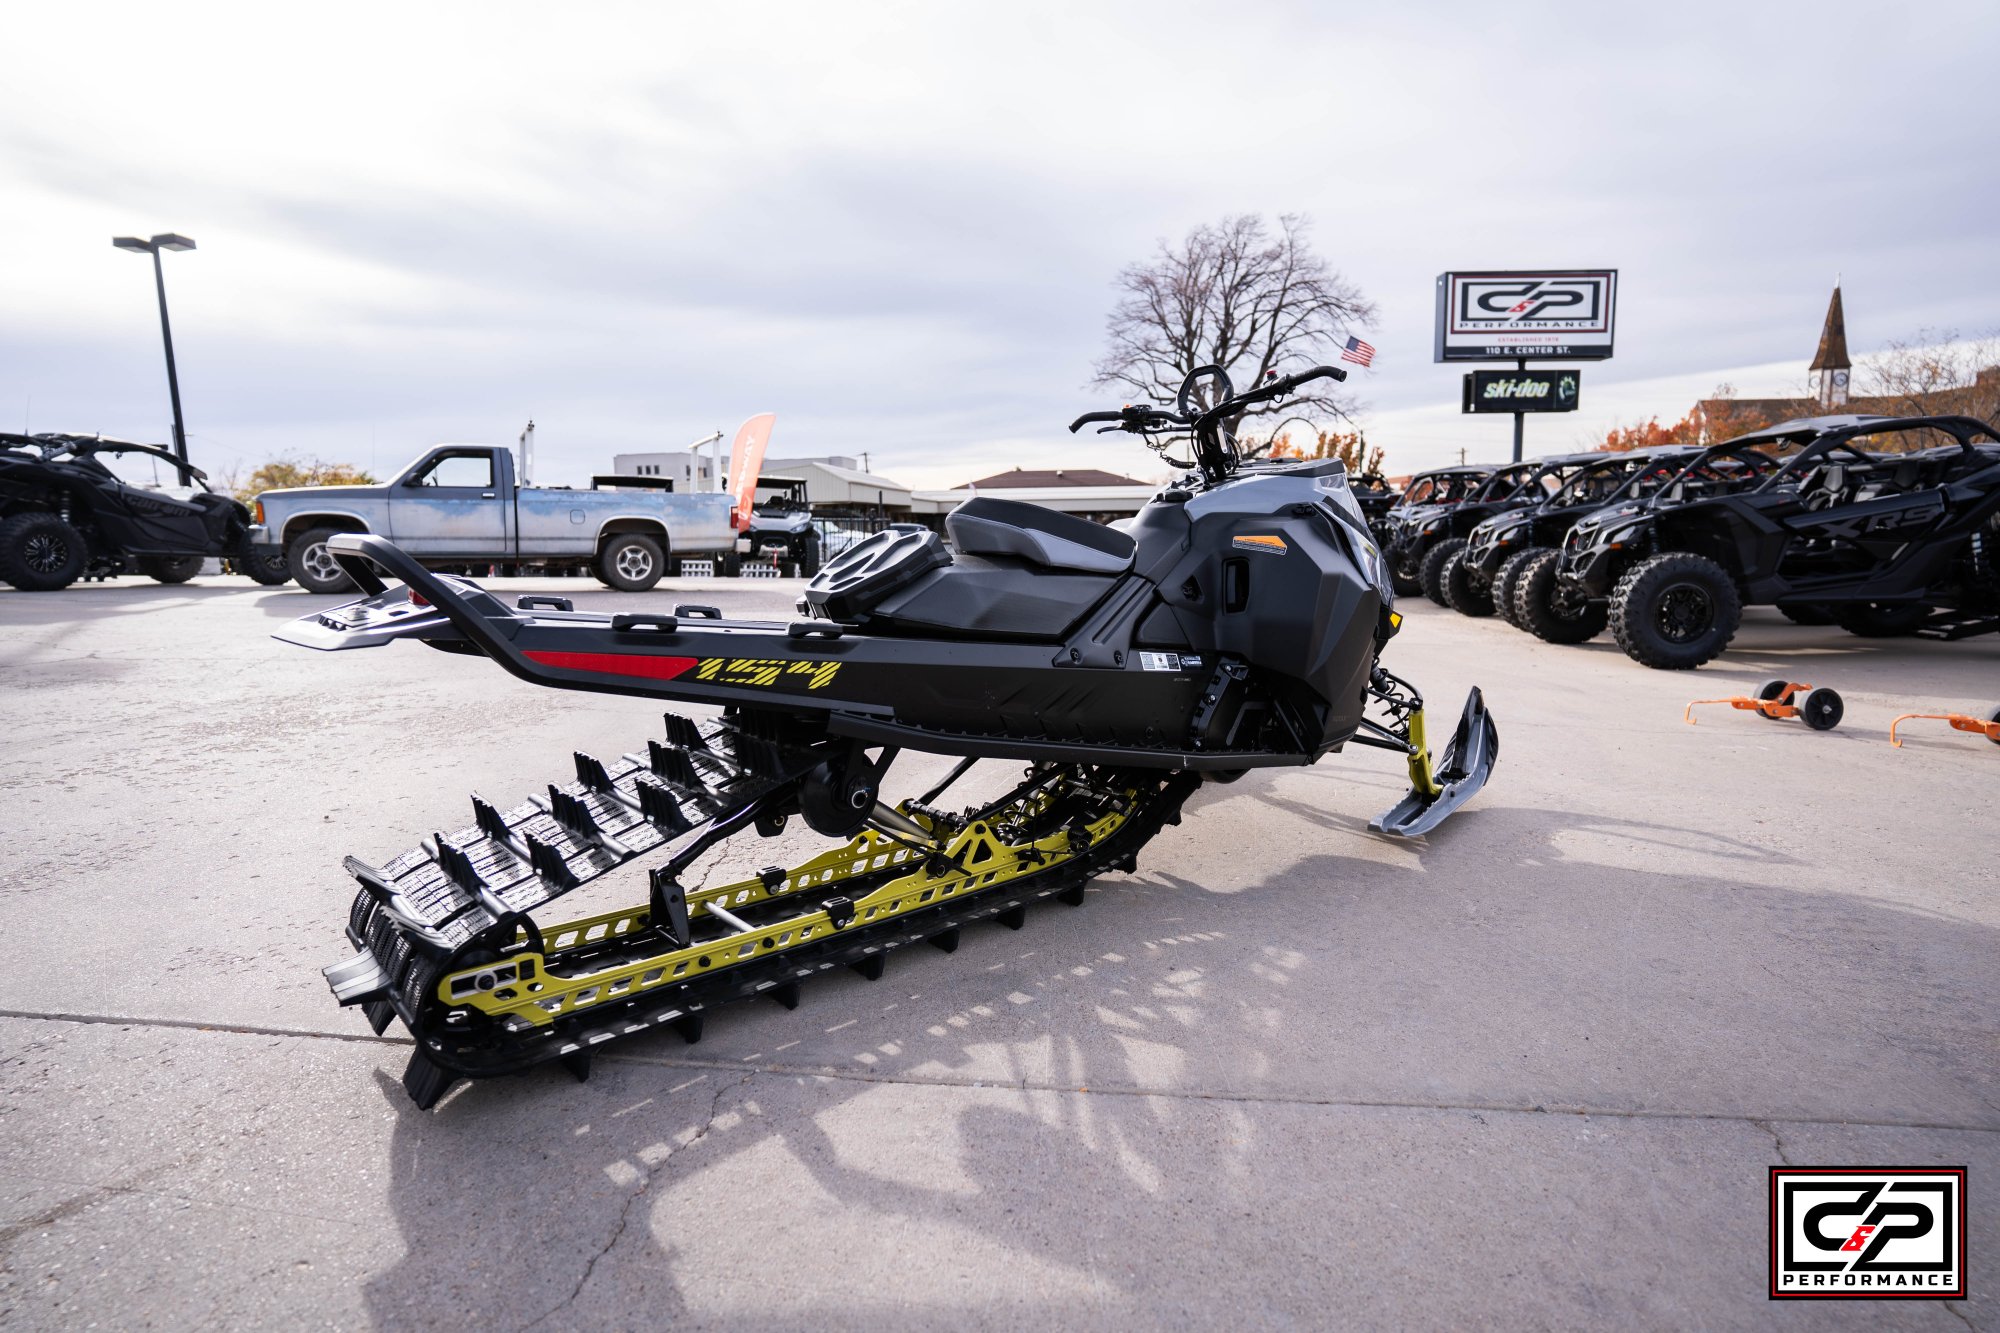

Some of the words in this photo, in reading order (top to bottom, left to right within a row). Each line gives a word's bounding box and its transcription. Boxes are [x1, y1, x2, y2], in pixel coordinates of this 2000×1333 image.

[1459, 320, 1599, 328] PERFORMANCE
[1485, 346, 1501, 354] 110
[1504, 346, 1513, 354] E.
[1516, 346, 1553, 354] CENTER
[1556, 346, 1571, 354] ST.
[1483, 378, 1550, 398] ski-doo
[696, 658, 842, 689] 154
